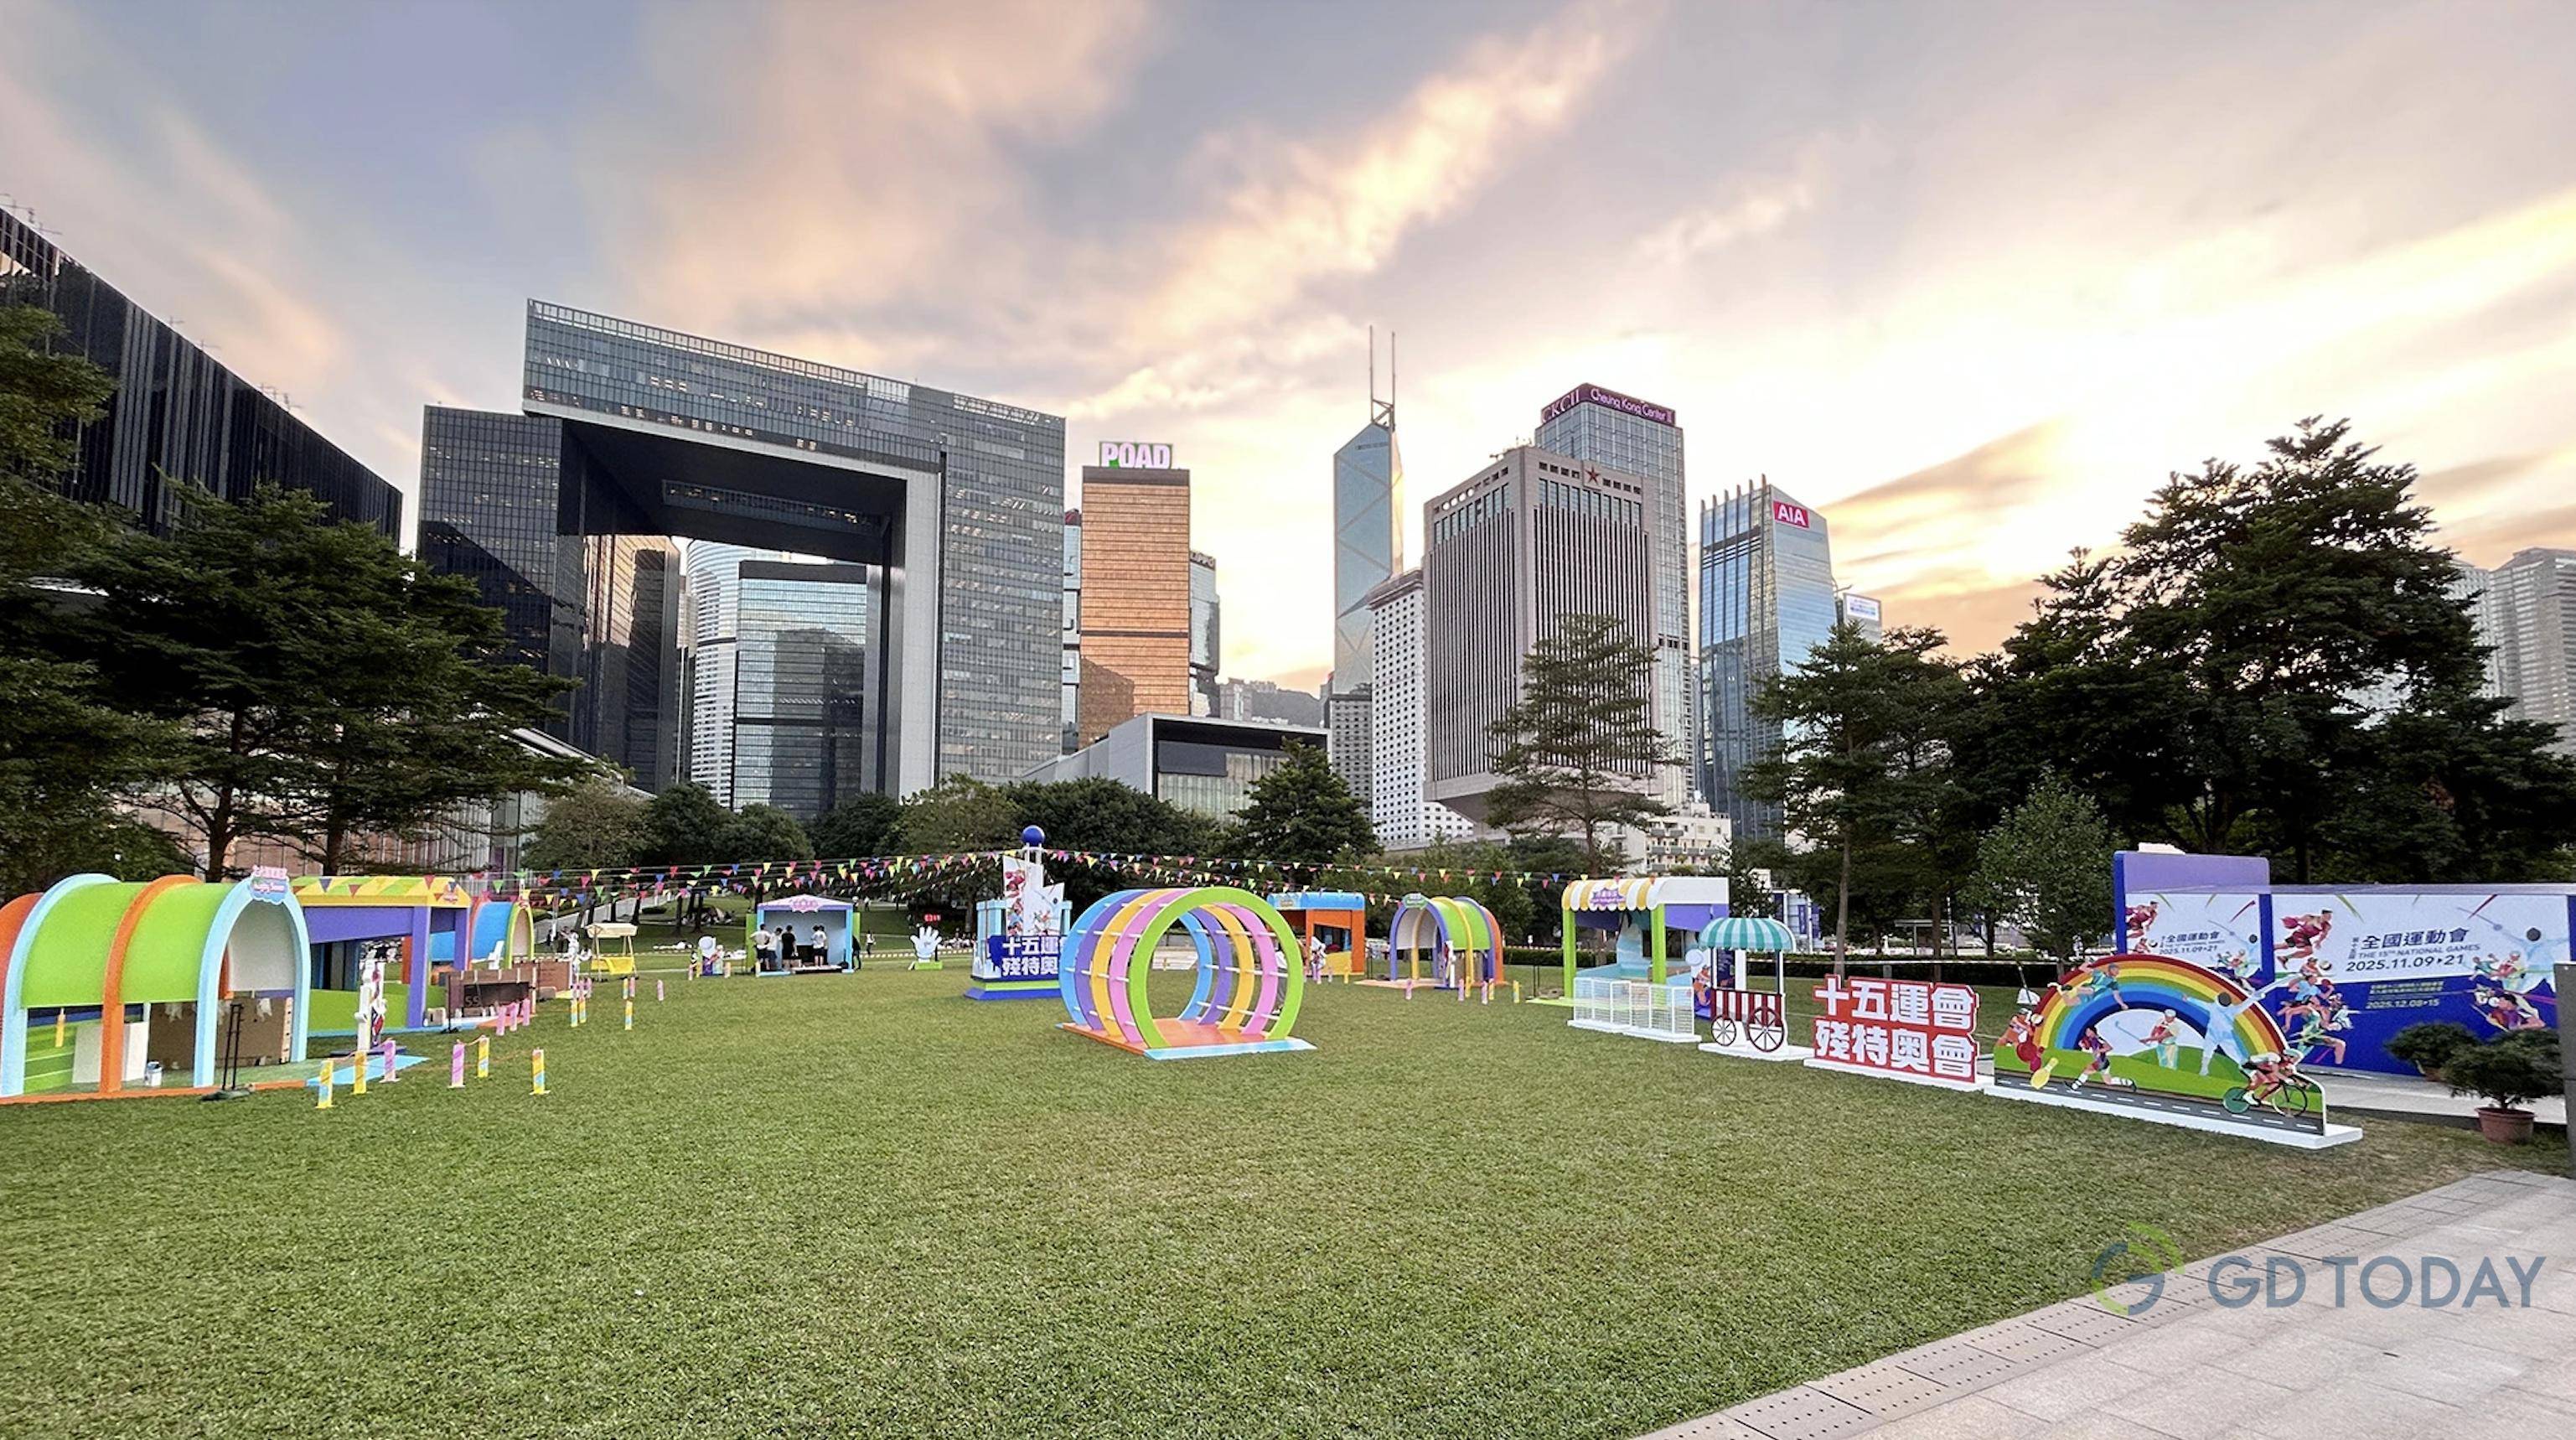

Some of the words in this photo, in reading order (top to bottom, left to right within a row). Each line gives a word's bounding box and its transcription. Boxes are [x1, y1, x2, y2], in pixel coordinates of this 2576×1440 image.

[1591, 387, 1621, 409] Cheung
[1622, 398, 1642, 416] Kong
[1642, 403, 1666, 421] Center
[1100, 442, 1172, 469] POAD
[1777, 504, 1806, 526] AIA
[2361, 927, 2470, 950] 全國運動會
[2446, 944, 2480, 953] GAMES
[1814, 977, 1974, 1030] 十五運會
[1815, 1019, 1976, 1078] 殘特奧會
